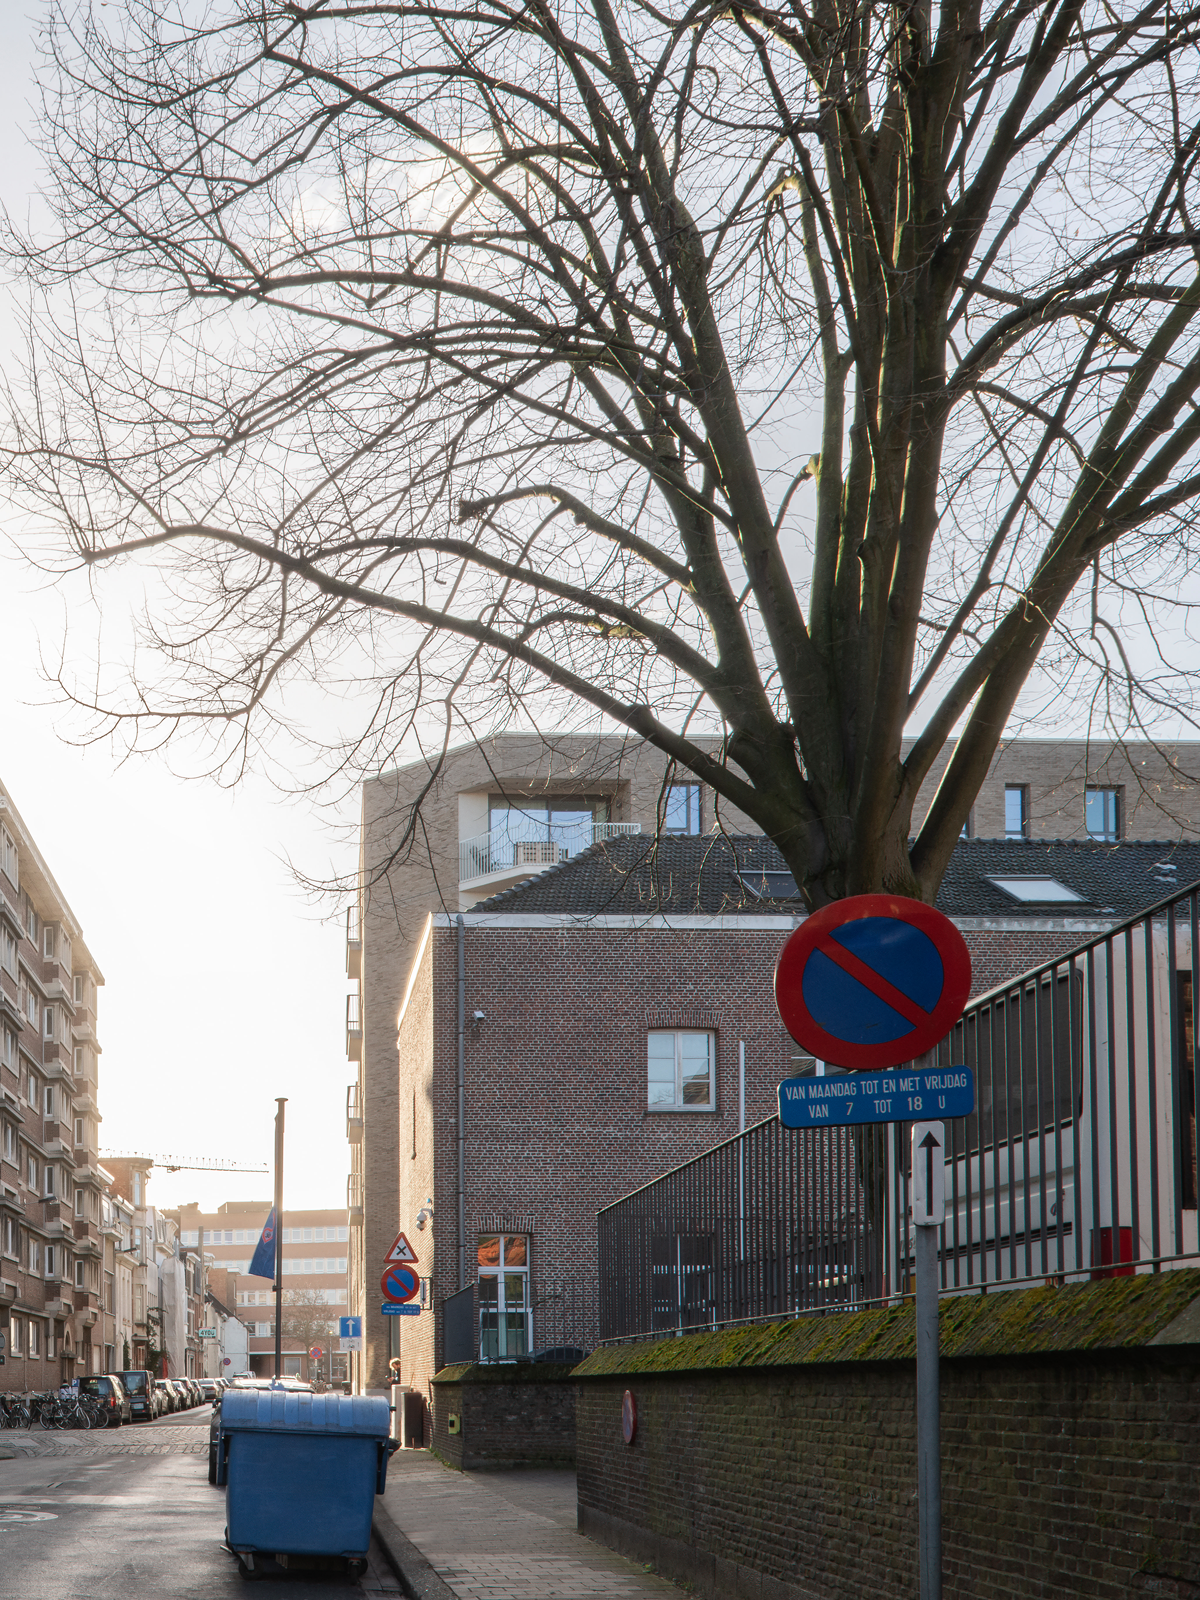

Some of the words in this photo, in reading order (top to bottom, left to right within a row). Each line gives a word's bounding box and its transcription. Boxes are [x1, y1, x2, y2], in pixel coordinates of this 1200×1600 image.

[785, 1086, 806, 1100] VAN
[809, 1082, 857, 1099] MAANDAG
[860, 1080, 879, 1095] TOT
[882, 1079, 896, 1093] EN
[899, 1077, 920, 1092] MET
[924, 1073, 967, 1090] VRIJDAG
[808, 1104, 829, 1119] VAN
[846, 1102, 854, 1116] 7
[873, 1099, 892, 1114] TOT
[907, 1096, 923, 1111] 18
[938, 1095, 946, 1109] U
